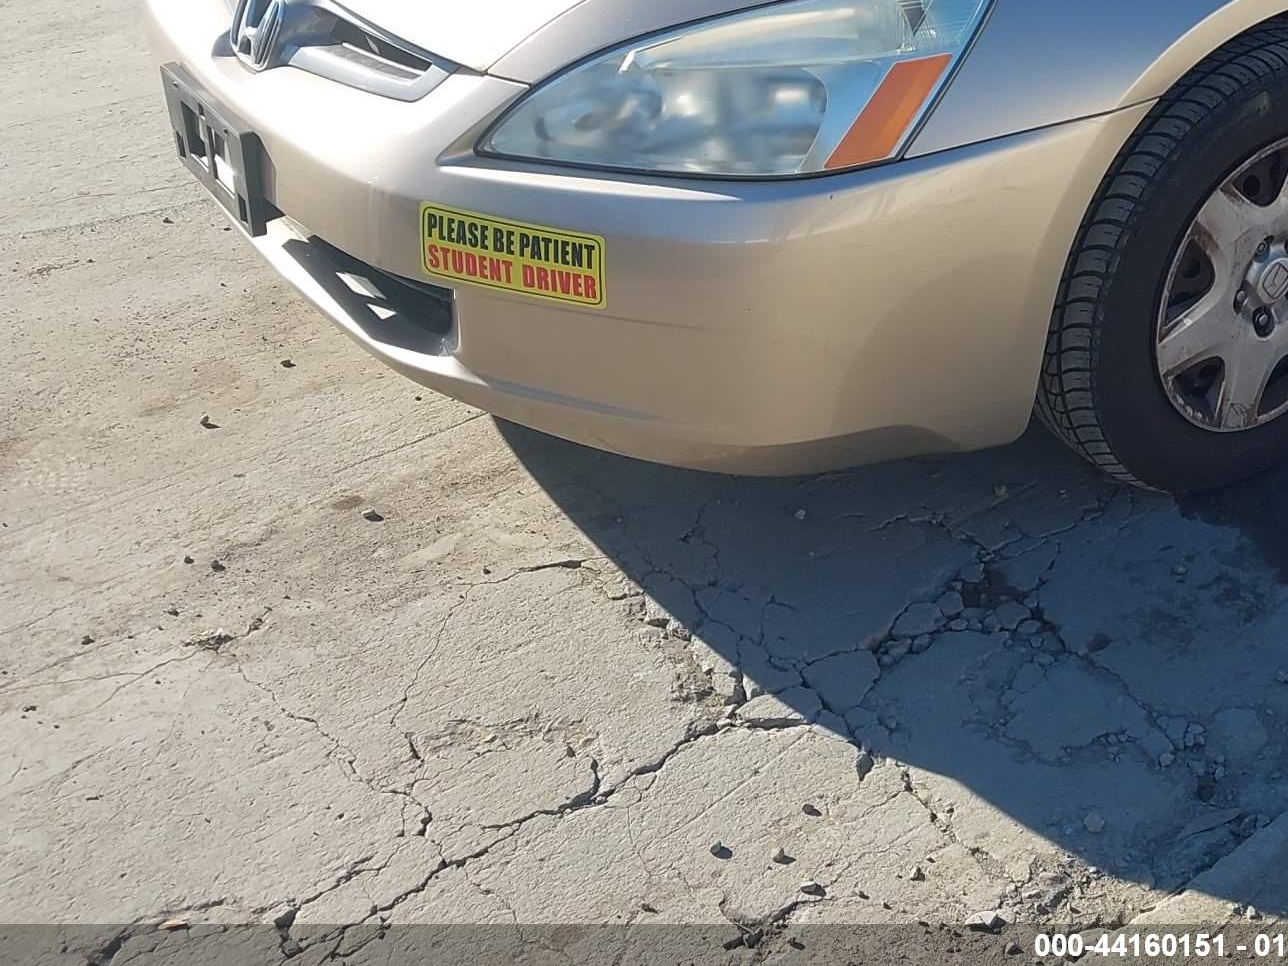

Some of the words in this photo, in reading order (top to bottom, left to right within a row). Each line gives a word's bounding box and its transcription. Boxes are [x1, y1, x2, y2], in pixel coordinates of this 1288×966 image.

[426, 212, 489, 251] PLEASE
[492, 226, 515, 256] BE
[518, 232, 596, 270] PATIENT
[427, 243, 513, 284] STUDENT
[521, 263, 598, 300] DRIVER
